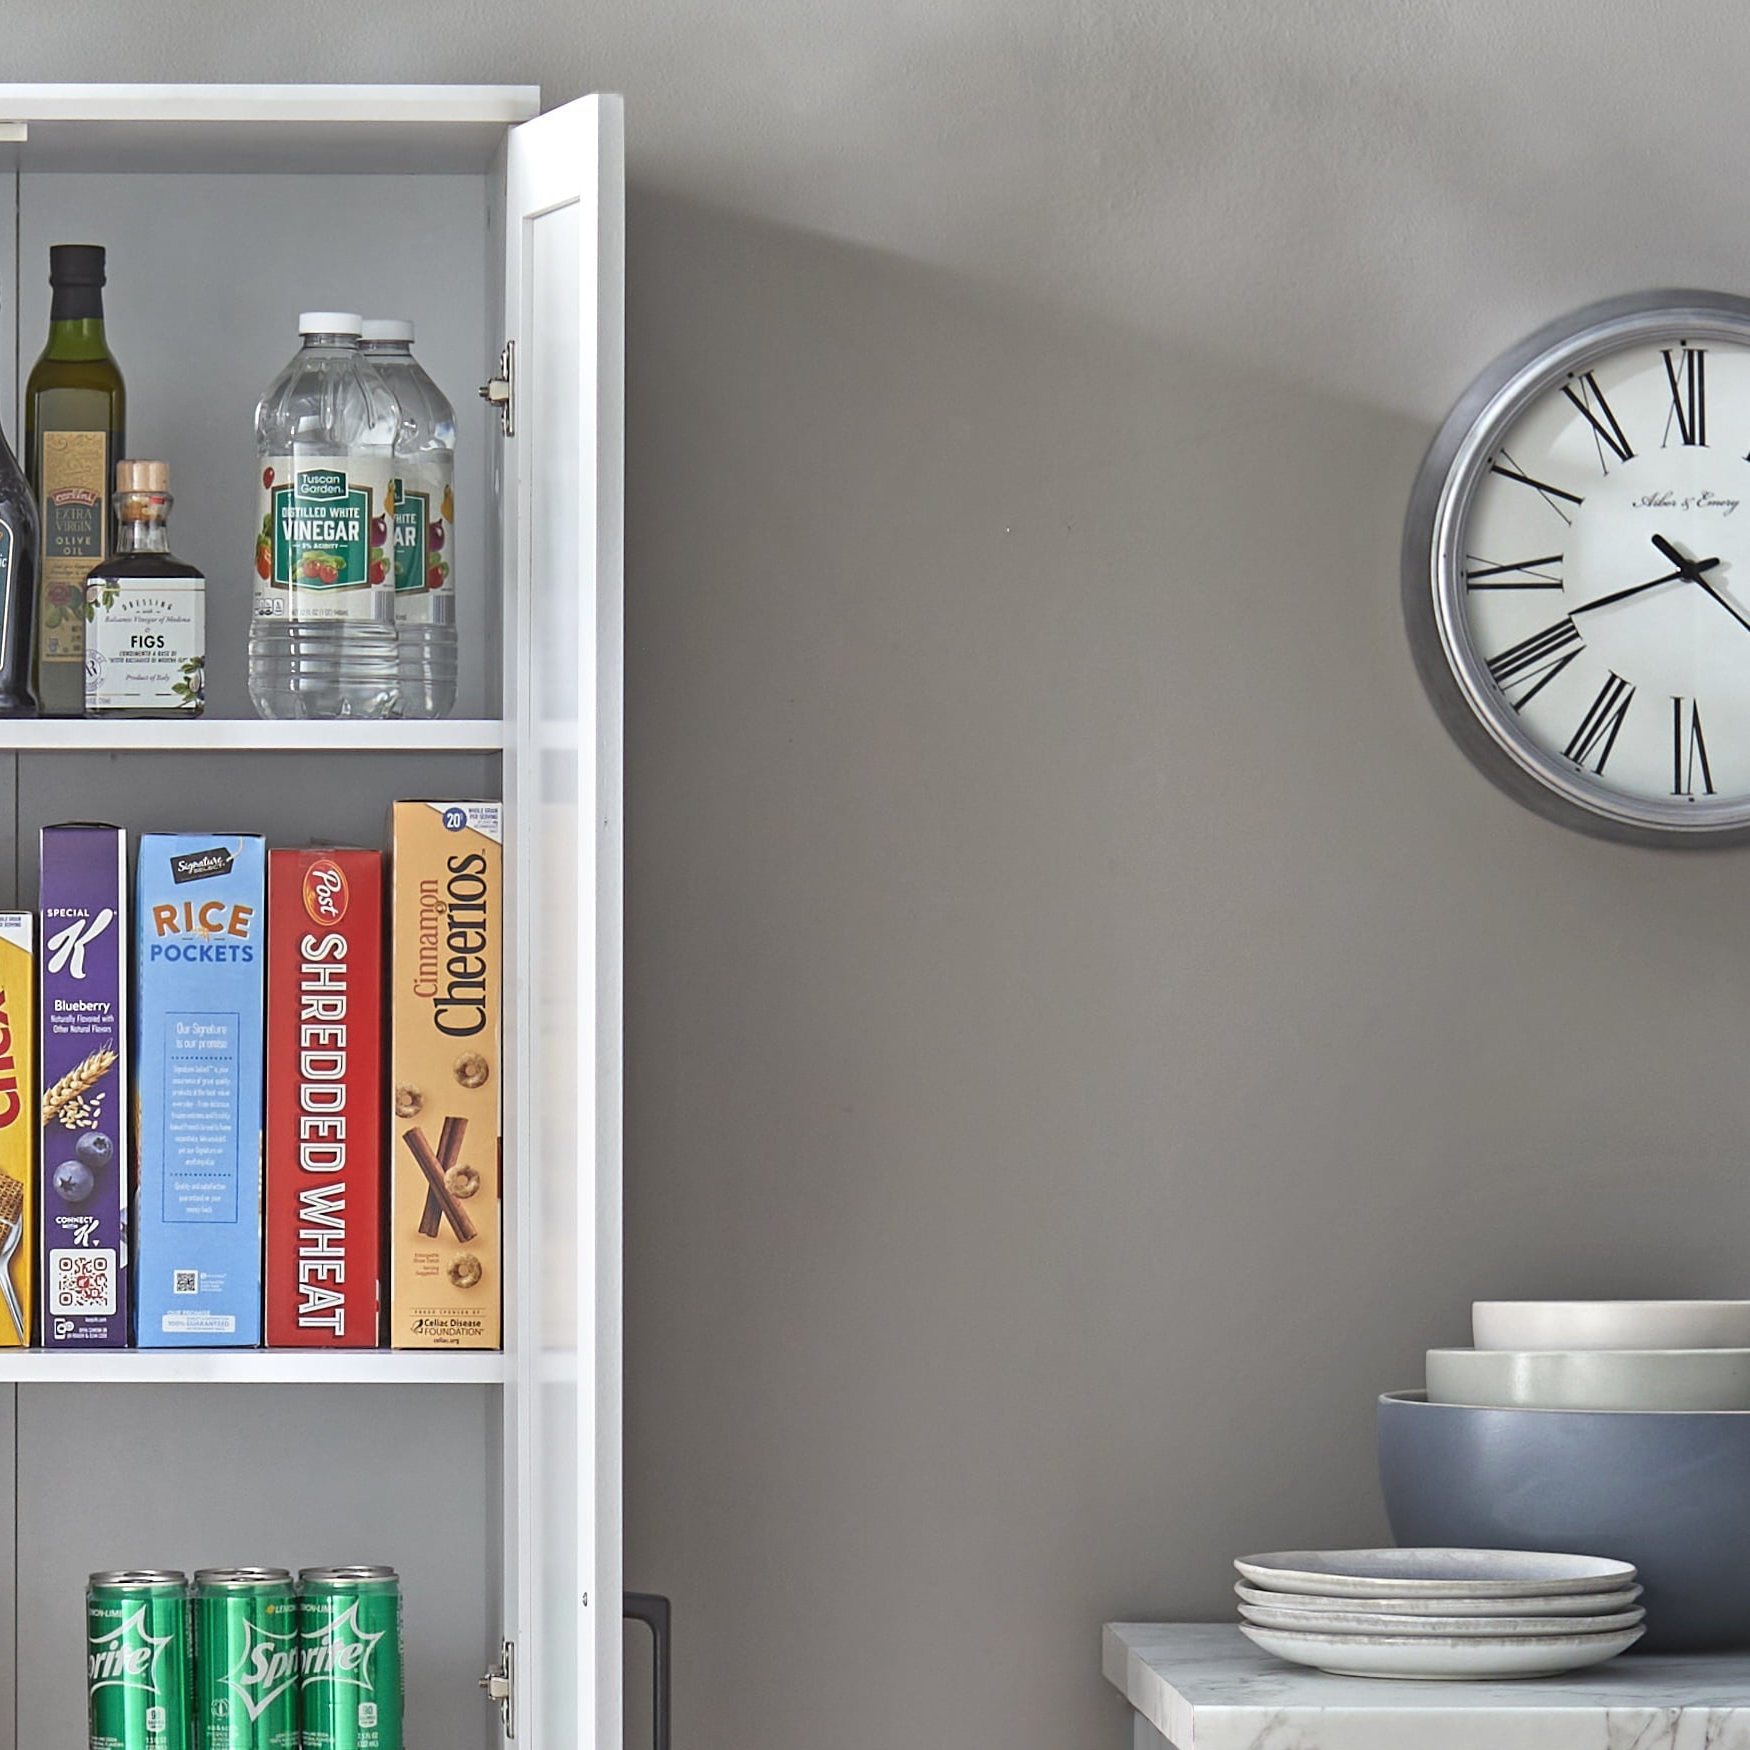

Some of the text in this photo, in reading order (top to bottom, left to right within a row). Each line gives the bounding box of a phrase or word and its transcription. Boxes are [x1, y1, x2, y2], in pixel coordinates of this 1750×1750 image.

[1560, 369, 1637, 476] XI
[301, 473, 341, 484] Tuscan
[1488, 448, 1585, 528] X
[300, 484, 342, 495] Garden
[55, 508, 93, 520] EXTRA
[281, 506, 360, 519] DISTILLED WHITE
[55, 520, 93, 532] VIRGIN
[281, 520, 360, 541] VINEGAR
[55, 536, 92, 546] OLIVE
[63, 546, 84, 556] OIL
[1465, 553, 1565, 594] IX
[131, 634, 166, 649] FIGS
[1670, 696, 1715, 795] VI
[177, 855, 223, 875] Signature
[312, 869, 342, 918] Post
[46, 908, 91, 918] SPECIAL
[152, 901, 254, 938] RICE
[47, 908, 114, 979] K
[413, 879, 439, 999] Cinnamon
[433, 853, 487, 1038] Cheerios
[150, 944, 254, 962] POCKETS
[53, 999, 111, 1015] Blueberry
[176, 1021, 227, 1037] Our Signature
[300, 933, 348, 1173] SHREDDED
[299, 1182, 346, 1337] WHEAT
[450, 1318, 482, 1328] Disease
